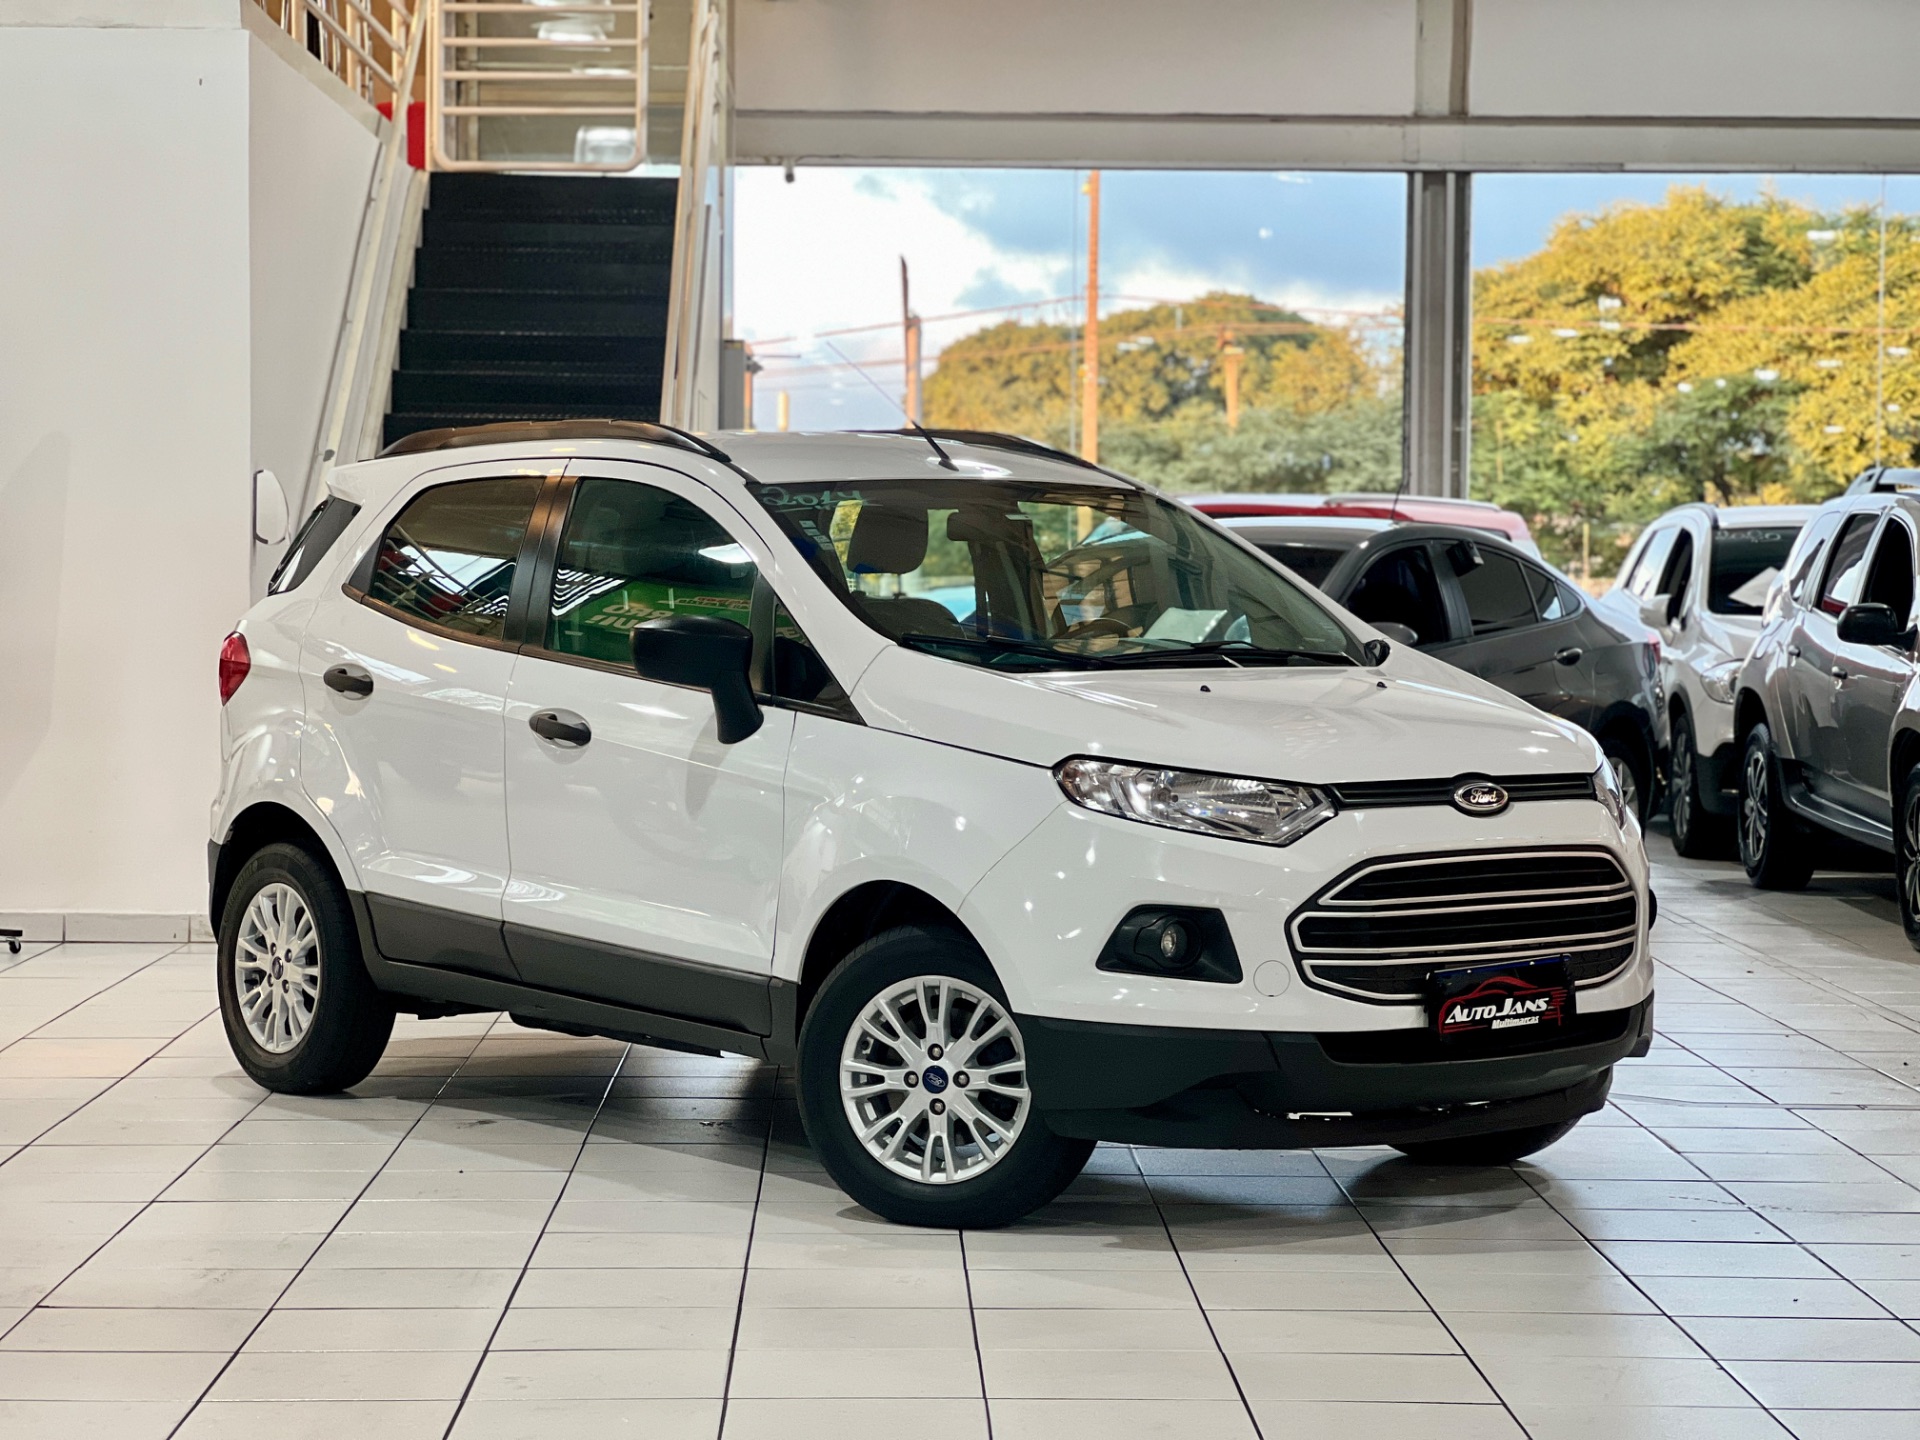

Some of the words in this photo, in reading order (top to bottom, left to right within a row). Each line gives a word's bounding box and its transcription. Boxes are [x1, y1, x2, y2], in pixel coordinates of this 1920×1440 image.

[761, 486, 870, 506] 2014
[1470, 787, 1498, 804] Ford
[1491, 1015, 1540, 1030] Multimarcas
